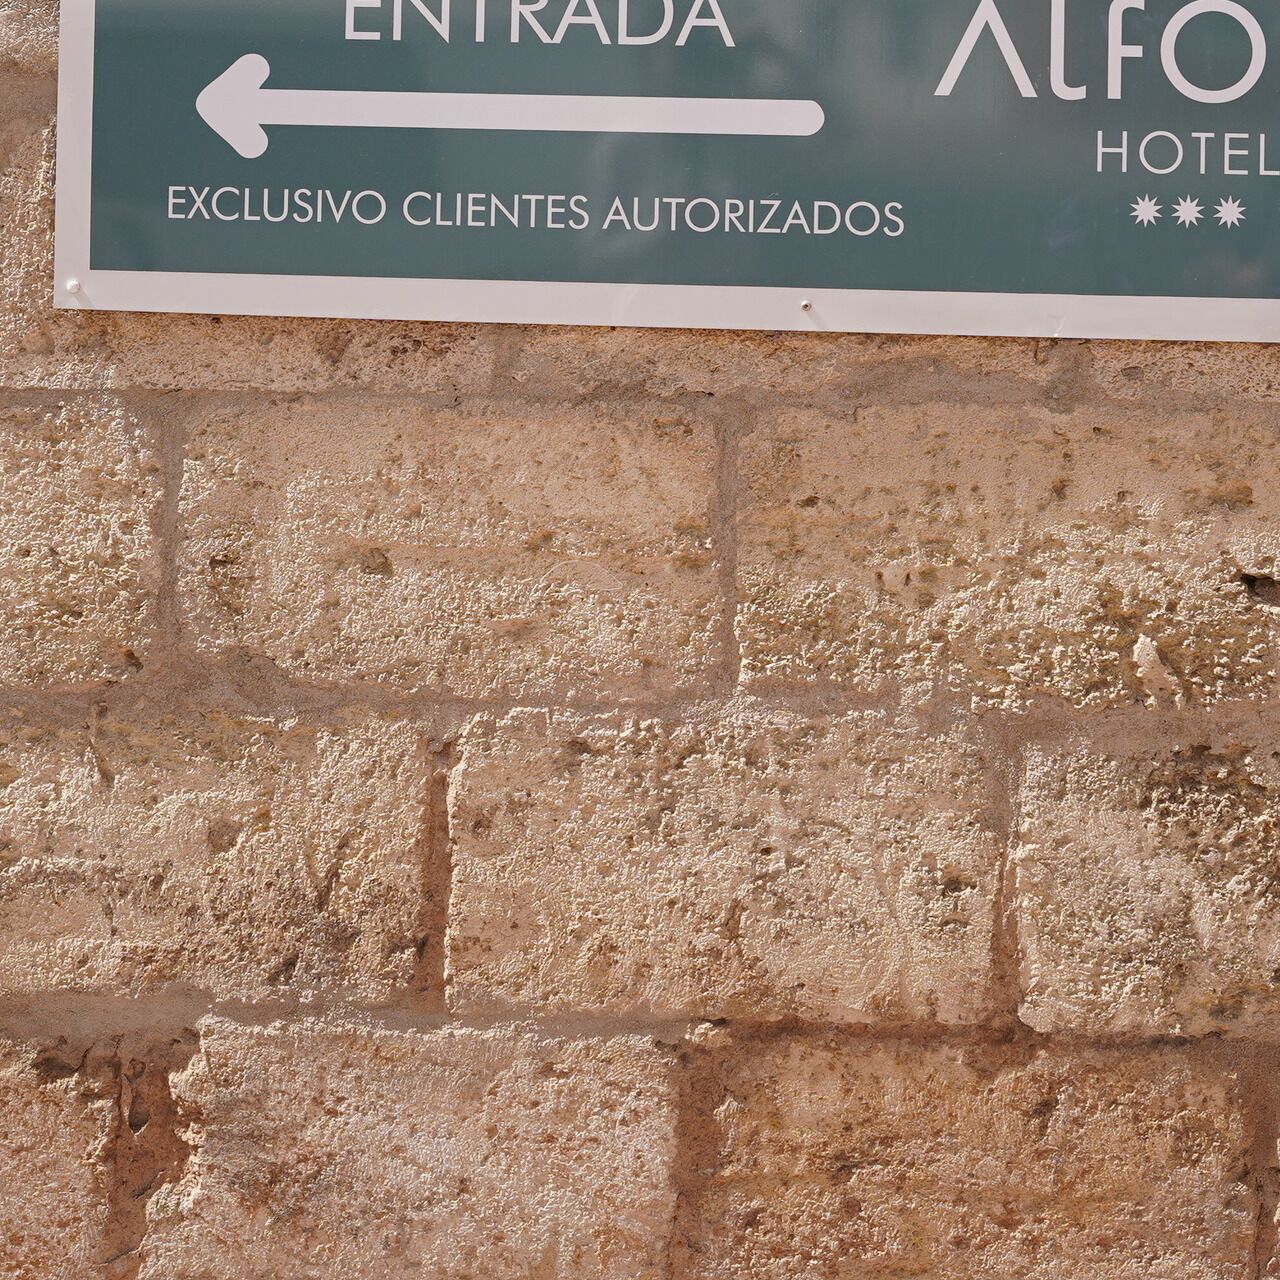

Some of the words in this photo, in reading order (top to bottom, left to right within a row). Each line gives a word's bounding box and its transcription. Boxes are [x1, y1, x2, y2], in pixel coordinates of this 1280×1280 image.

[1096, 130, 1280, 176] HOTEL
[167, 185, 387, 225] EXCLUSIVO
[402, 191, 590, 230] CLIENTES
[601, 195, 905, 237] AUTORIZADOS
